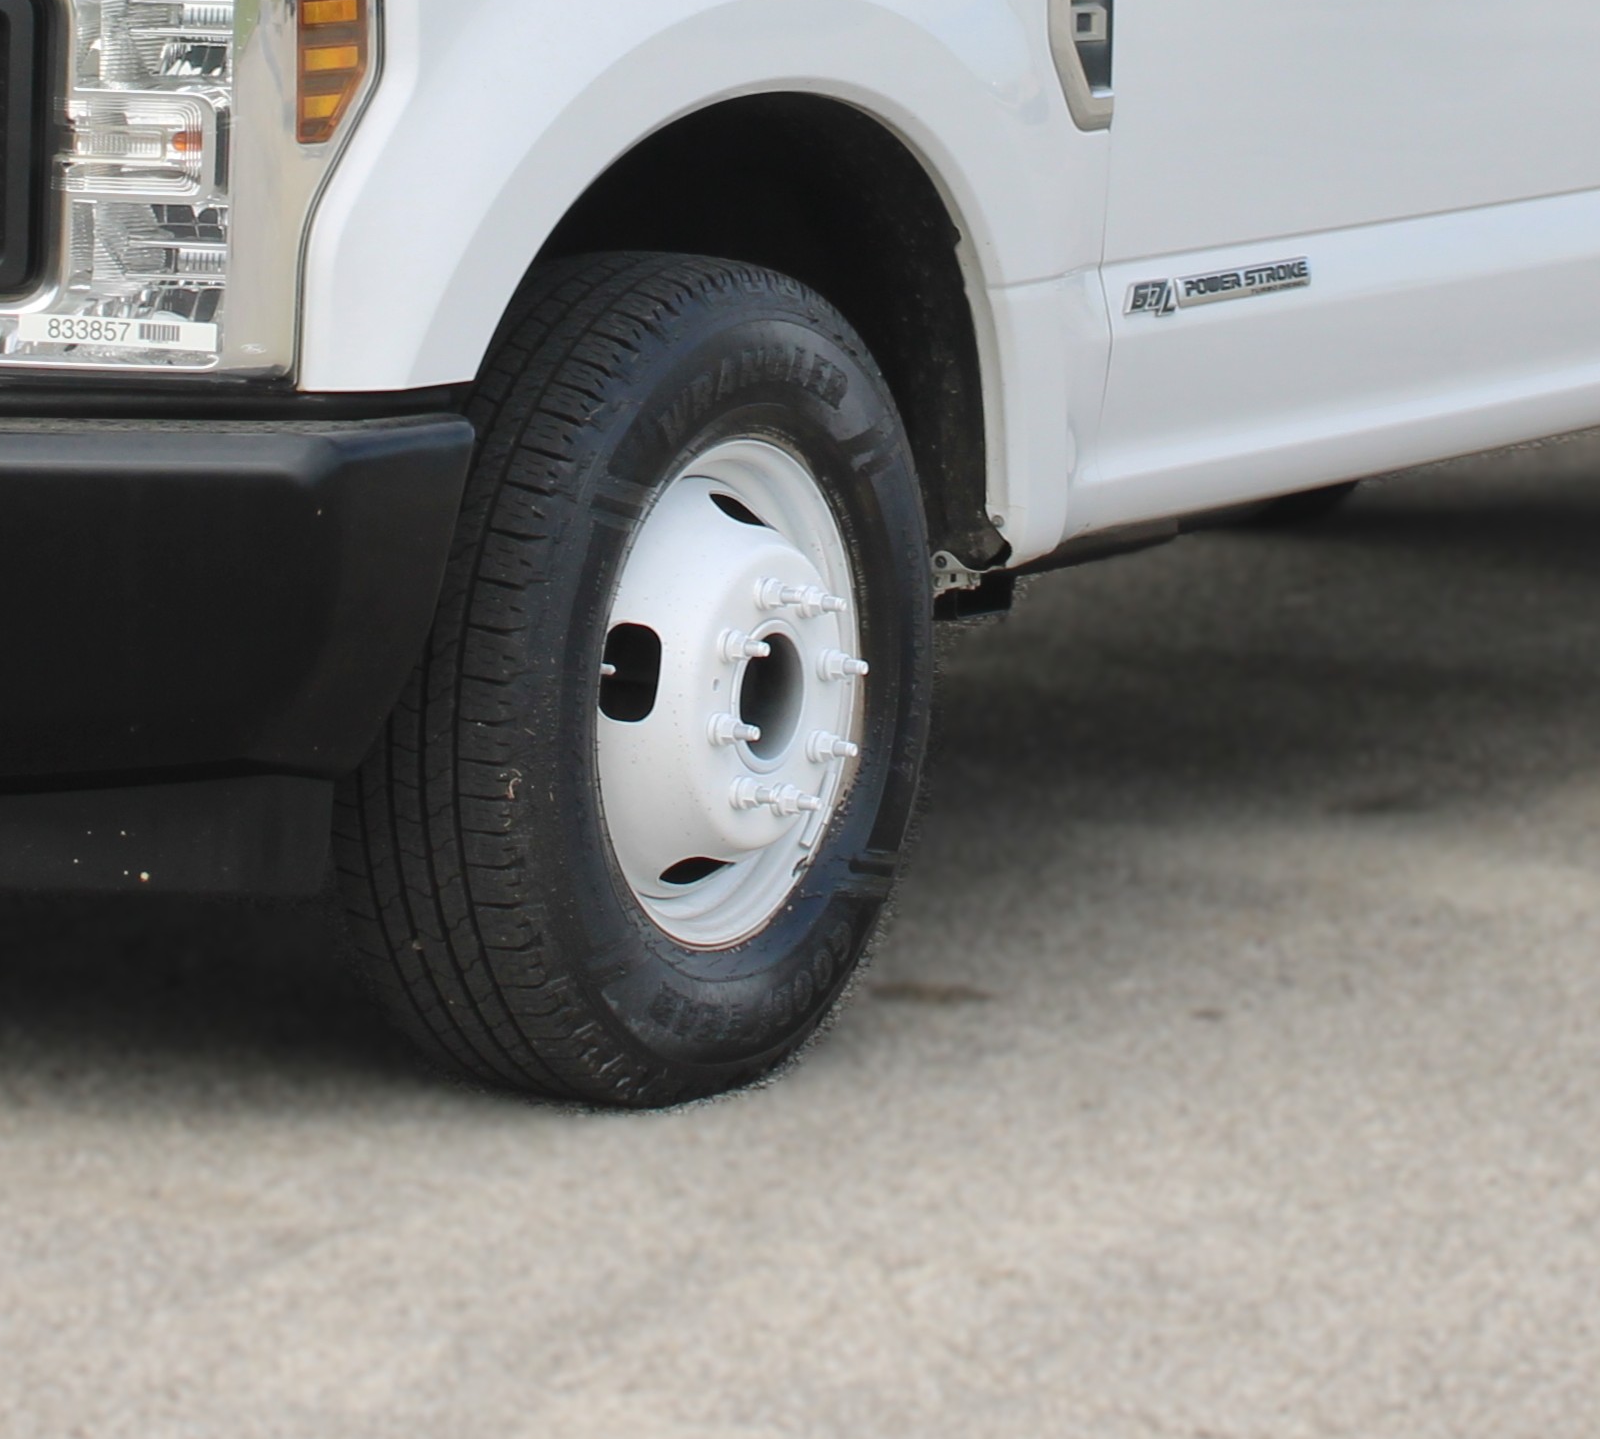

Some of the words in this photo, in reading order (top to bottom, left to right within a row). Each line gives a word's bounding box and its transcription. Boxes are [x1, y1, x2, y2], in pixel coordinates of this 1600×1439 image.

[1184, 272, 1242, 298] POWER
[1244, 261, 1308, 287] STROKE
[47, 318, 131, 342] 833857
